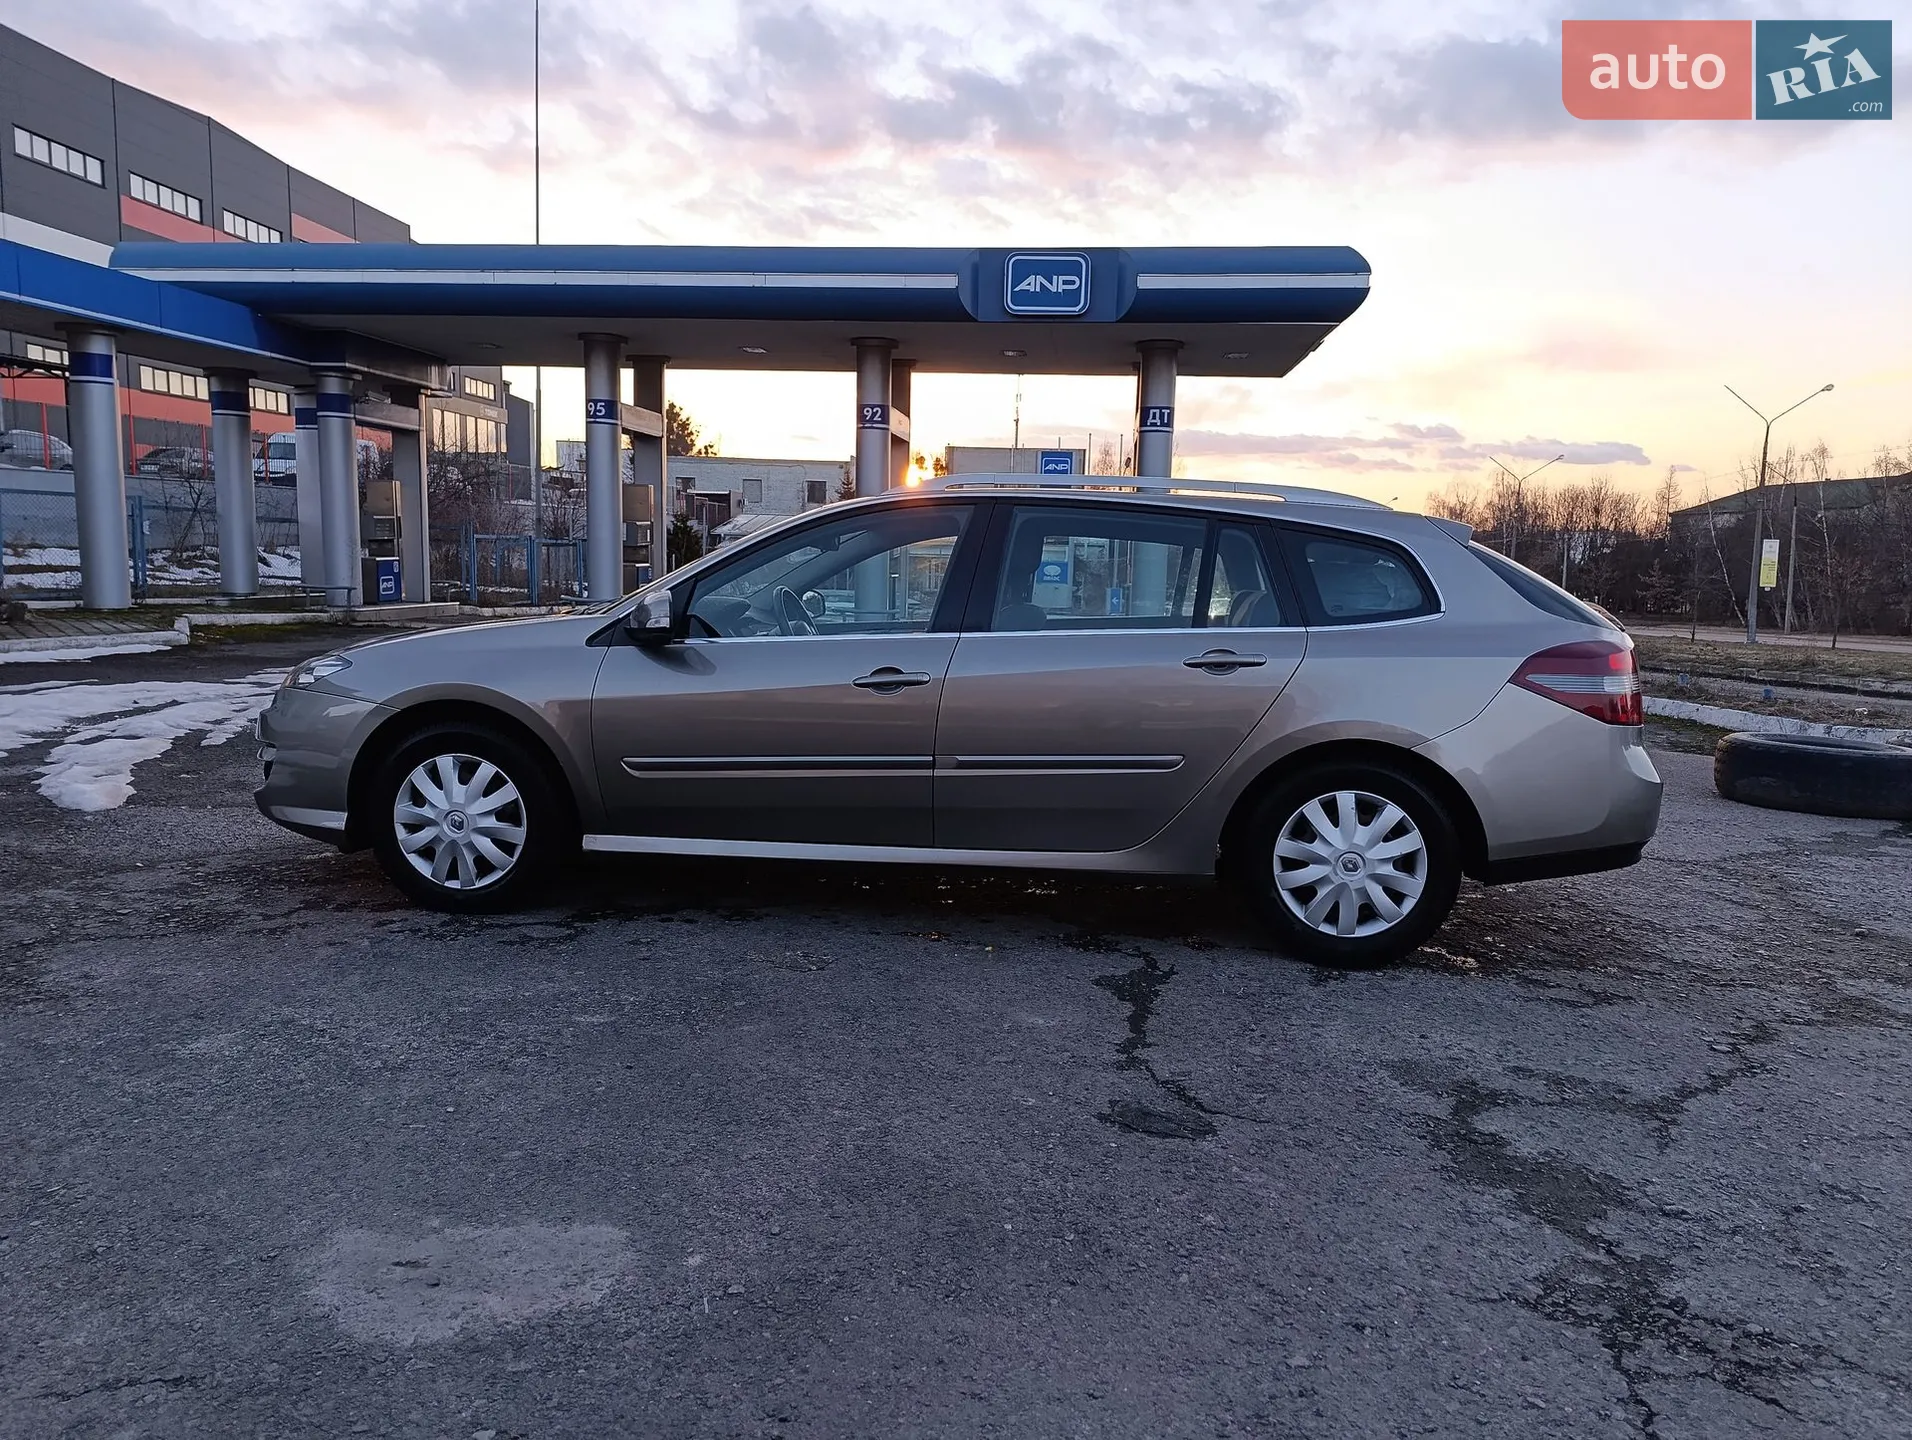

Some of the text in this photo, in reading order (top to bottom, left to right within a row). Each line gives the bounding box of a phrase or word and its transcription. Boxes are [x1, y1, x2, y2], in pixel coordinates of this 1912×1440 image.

[1013, 274, 1080, 292] ANP
[587, 402, 606, 416] 95
[863, 407, 882, 421] 92
[1147, 409, 1170, 426] ДТ
[1044, 463, 1069, 471] ANP
